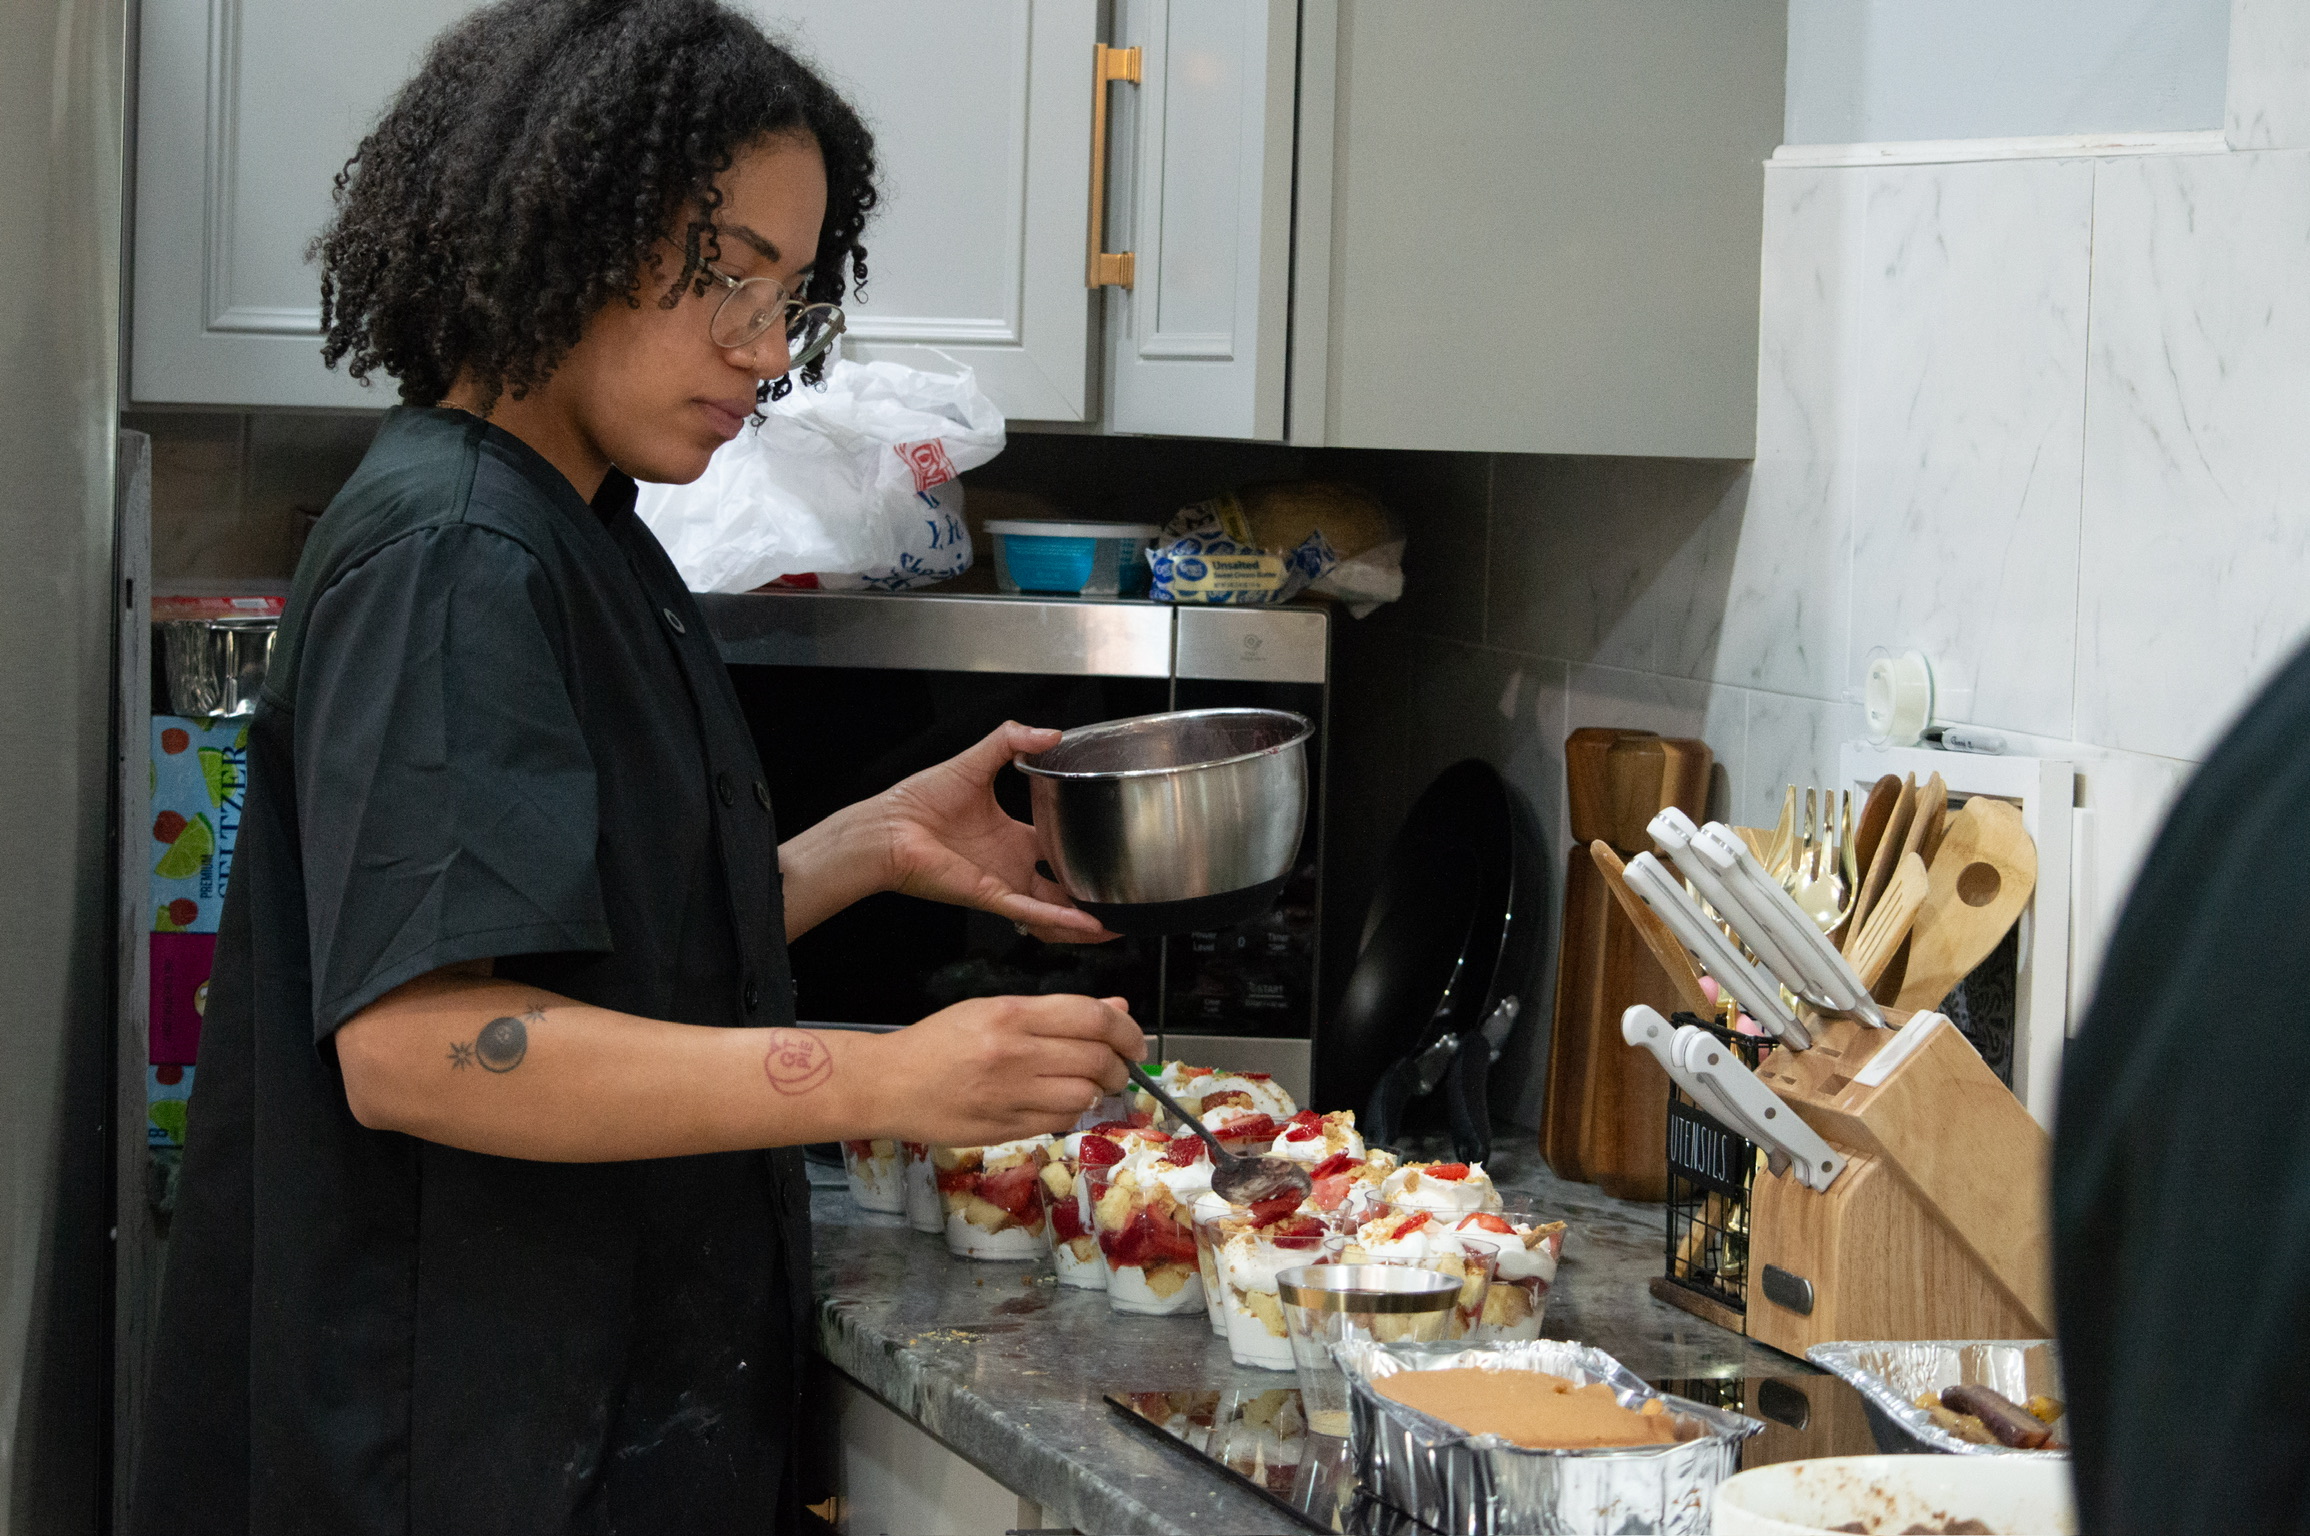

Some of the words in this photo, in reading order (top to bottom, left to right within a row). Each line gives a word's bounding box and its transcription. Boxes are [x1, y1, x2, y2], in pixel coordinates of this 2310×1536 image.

[1213, 561, 1259, 570] Unsalted
[218, 746, 246, 898] LTZER
[200, 854, 213, 898] PREMIUM
